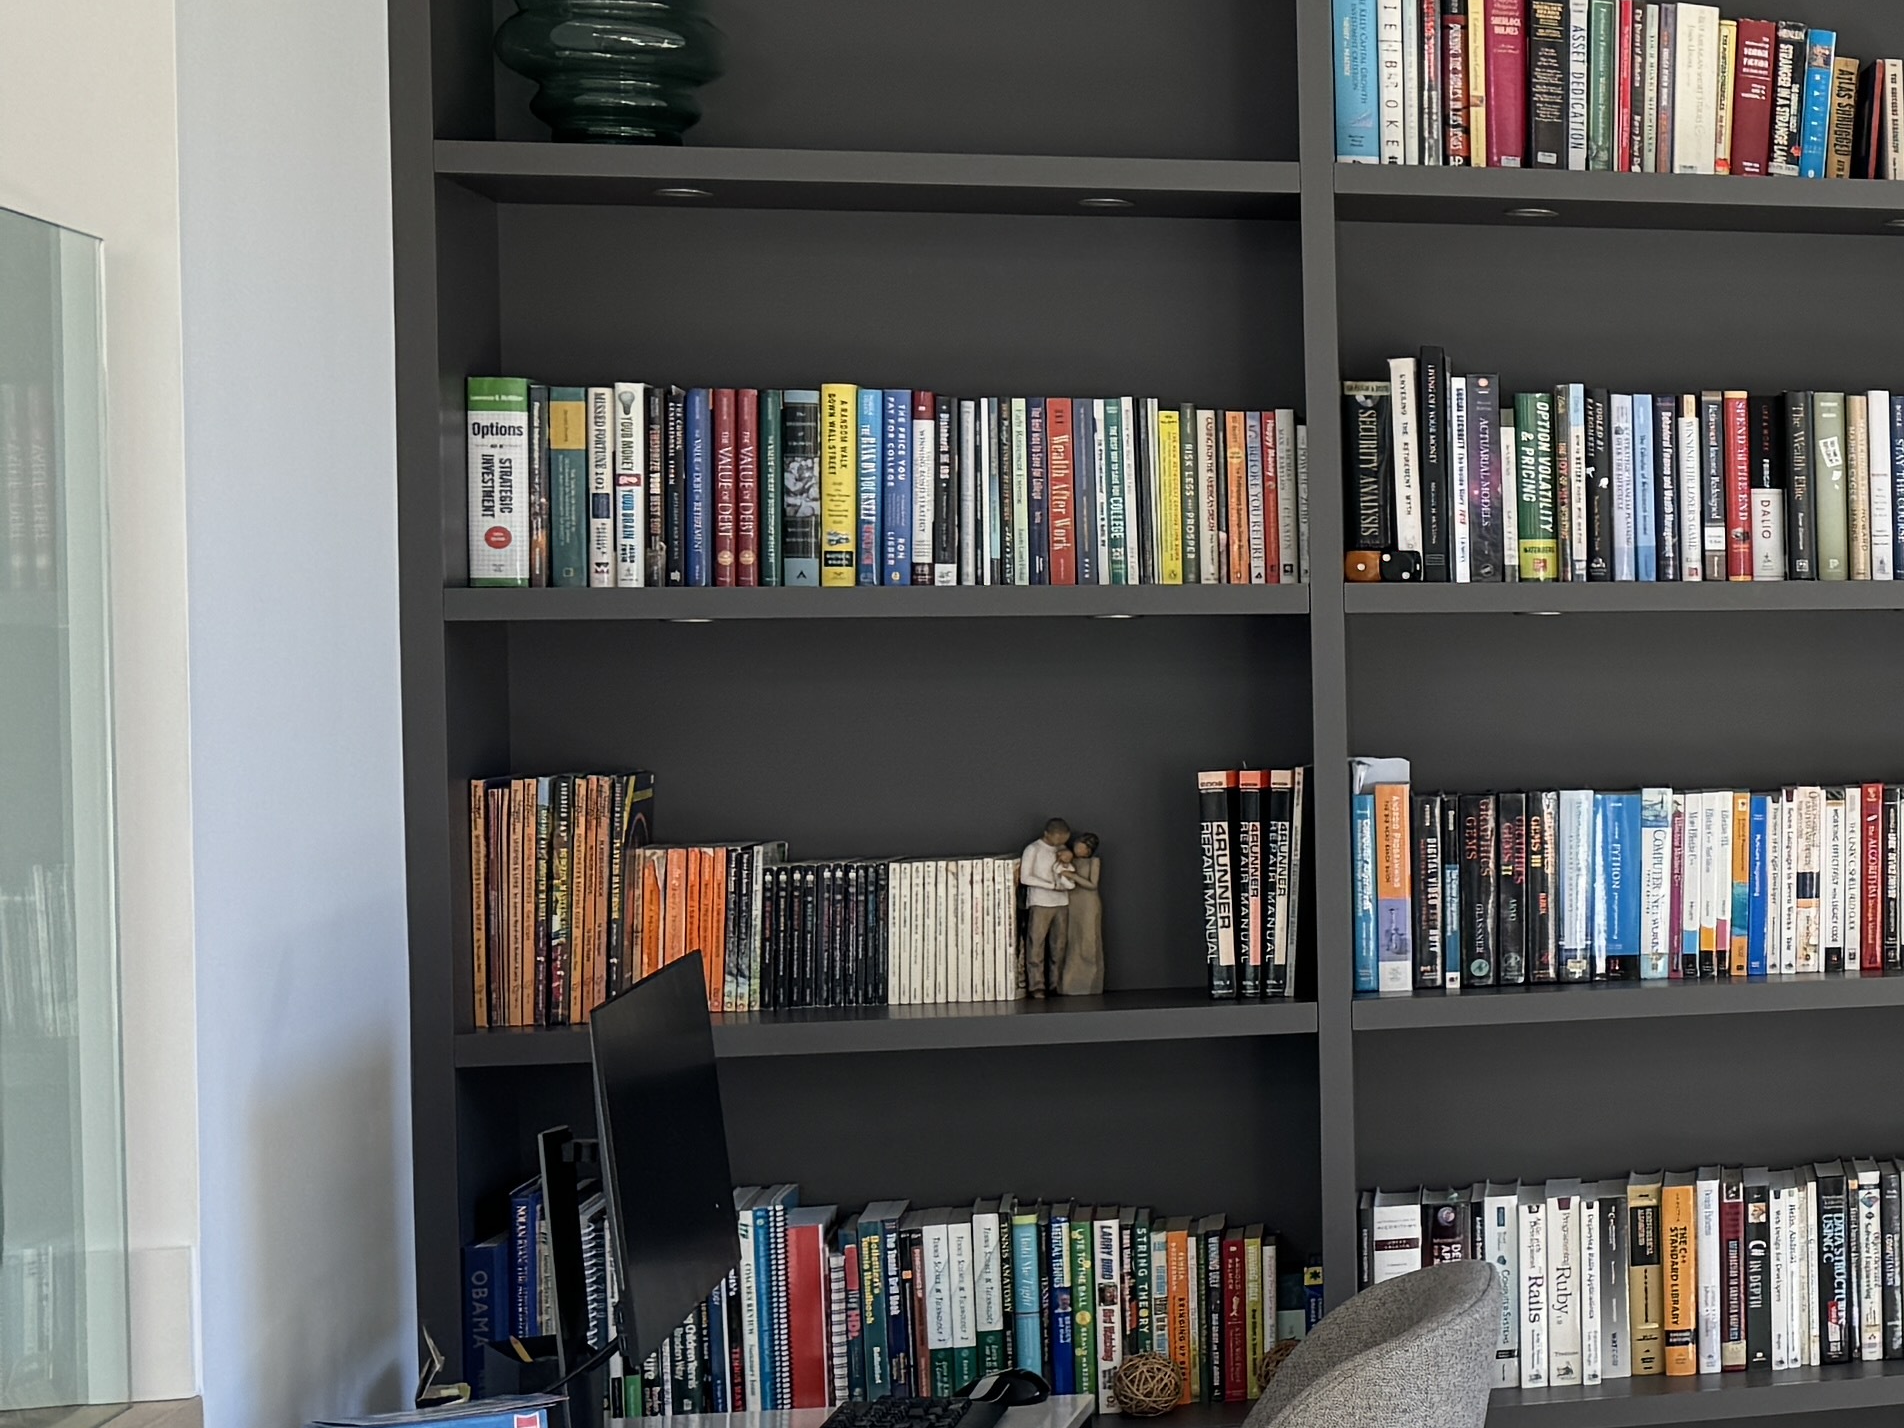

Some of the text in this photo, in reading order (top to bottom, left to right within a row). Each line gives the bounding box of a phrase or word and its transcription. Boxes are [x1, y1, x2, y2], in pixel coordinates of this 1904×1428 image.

[1571, 26, 1585, 149] ASSET DEDICATION
[1835, 69, 1854, 156] ATLAS SHRUGGED
[473, 422, 523, 436] Options
[594, 392, 607, 490] MISSED FORTUNE 101
[1536, 402, 1554, 531] OPTION VOLATILITY
[481, 454, 495, 517] INVESTMENT
[499, 458, 512, 513] STRATEGIC
[717, 447, 733, 538] VALUE DEBT
[739, 447, 754, 537] VALUE DEBT
[1051, 434, 1070, 550] Wealth After Work
[1185, 444, 1194, 559] RISK LESS PROSPER
[1248, 445, 1262, 563] BEFORE YOU RETIRE
[1358, 409, 1377, 535] SECURITY ANALYSIS
[1479, 418, 1492, 525] ACTUARIAL MODELS
[1523, 448, 1537, 501] PRICING
[1110, 497, 1124, 538] COLLEGE
[1760, 500, 1773, 539] DALIO
[1250, 824, 1260, 897] 4RUNNER
[1276, 822, 1287, 895] 4RUNNER
[1466, 817, 1478, 859] GEMS
[1478, 799, 1491, 876] GRAPHICS
[1531, 816, 1541, 852] GEMS
[1611, 844, 1622, 889] PYTHON
[1651, 830, 1666, 890] COMPUTER
[1866, 838, 1878, 897] ALGORITHM
[1202, 823, 1217, 963] REPAIR MANUAL
[1217, 824, 1231, 929] 4RUNNER
[1240, 822, 1249, 963] REPAIR MANUAL
[1266, 822, 1276, 962] REPAIR MANUAL
[1000, 1223, 1011, 1313] TENNIS ANATOMY
[1100, 1225, 1113, 1280] LARRY BIRD
[1678, 1227, 1686, 1245] THE
[1834, 1214, 1843, 1245] DATA
[472, 1271, 490, 1349] OBAMA
[1136, 1228, 1149, 1333] STRING THEORY
[1528, 1274, 1544, 1323] Rails
[1554, 1266, 1571, 1314] Ruby
[1670, 1228, 1679, 1325] STANDARD LIBRARY
